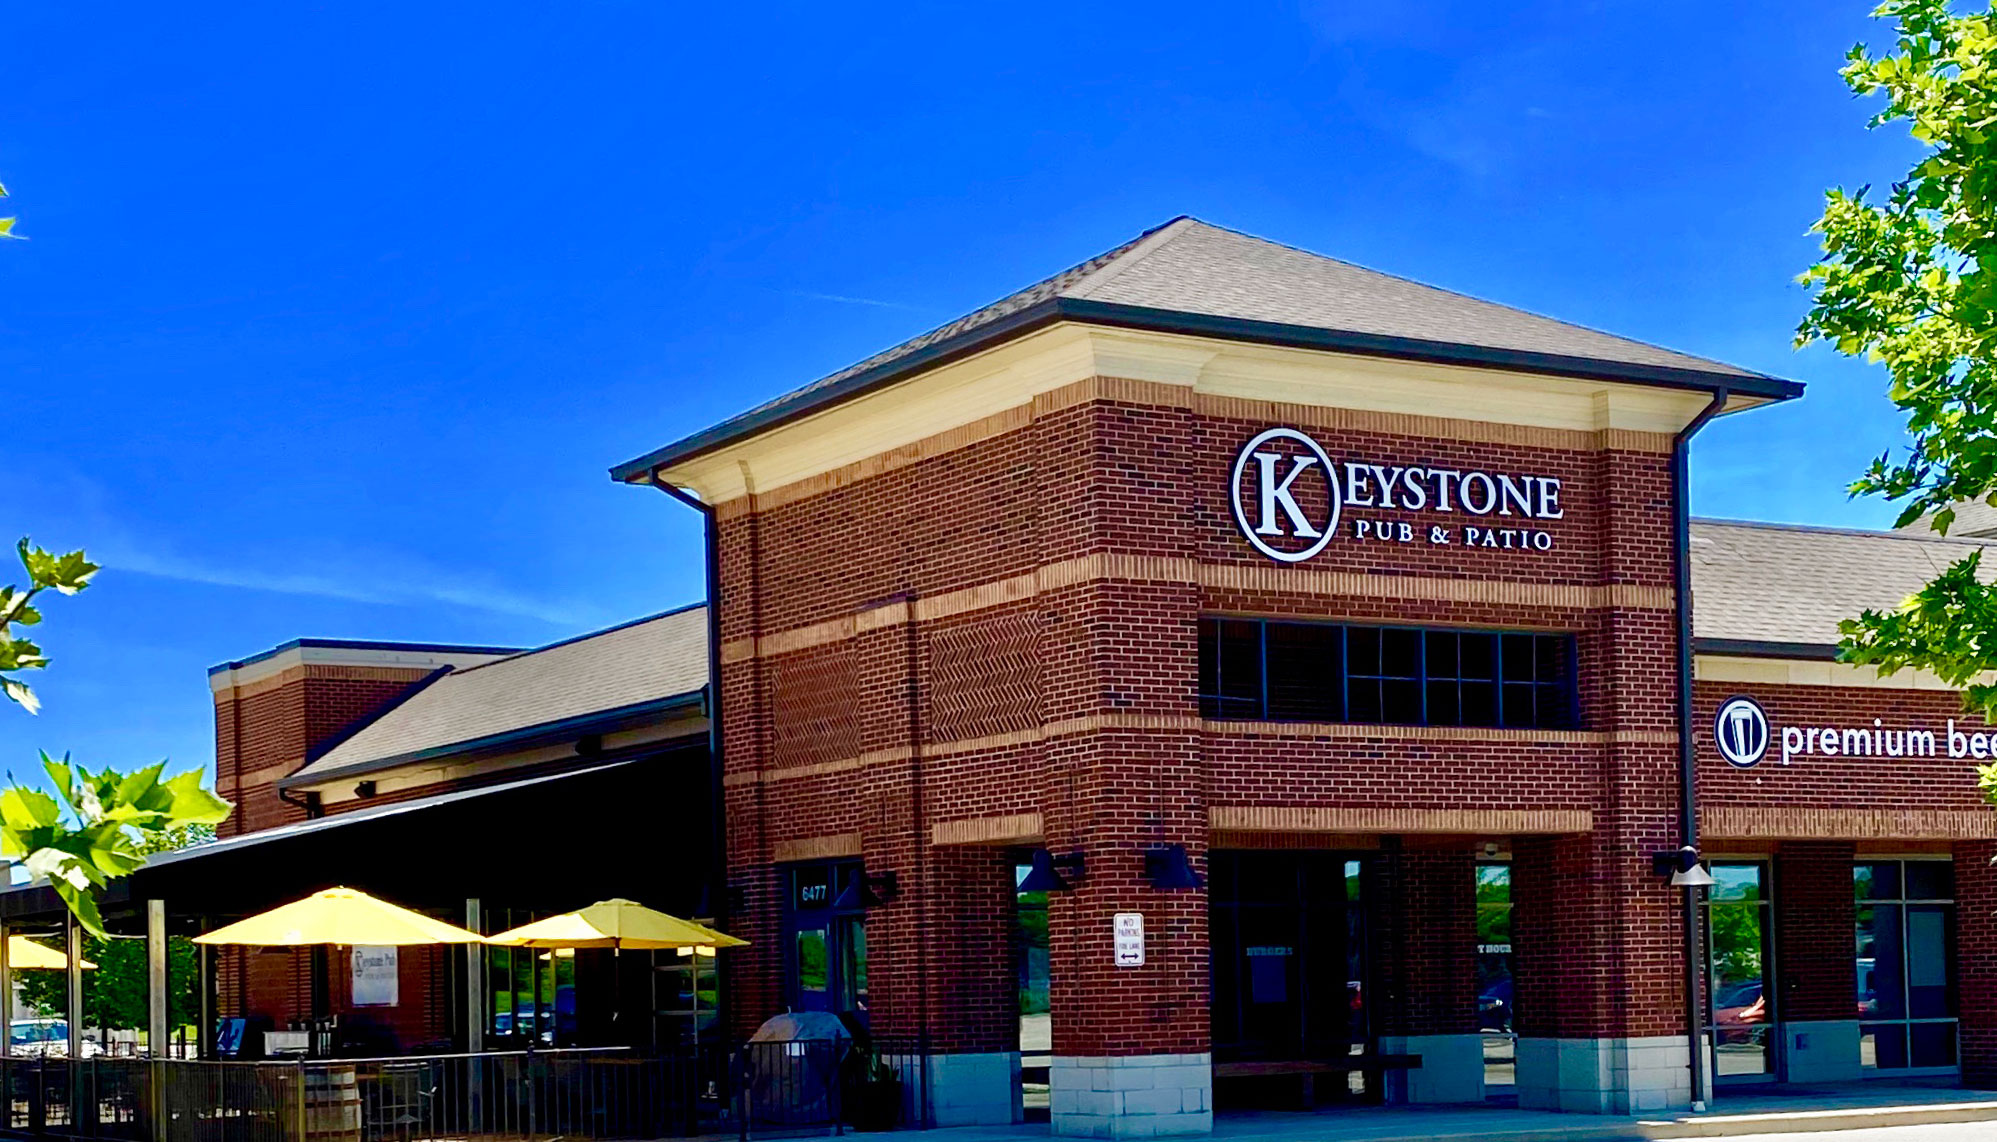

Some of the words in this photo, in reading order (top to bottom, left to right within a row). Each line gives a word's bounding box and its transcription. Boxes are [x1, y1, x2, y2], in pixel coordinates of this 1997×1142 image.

[1355, 520, 1415, 542] PUB
[1430, 525, 1450, 545] &
[1465, 527, 1553, 551] PATIO
[1781, 718, 1936, 766] premium
[802, 885, 827, 902] 6477
[1123, 918, 1134, 927] NO
